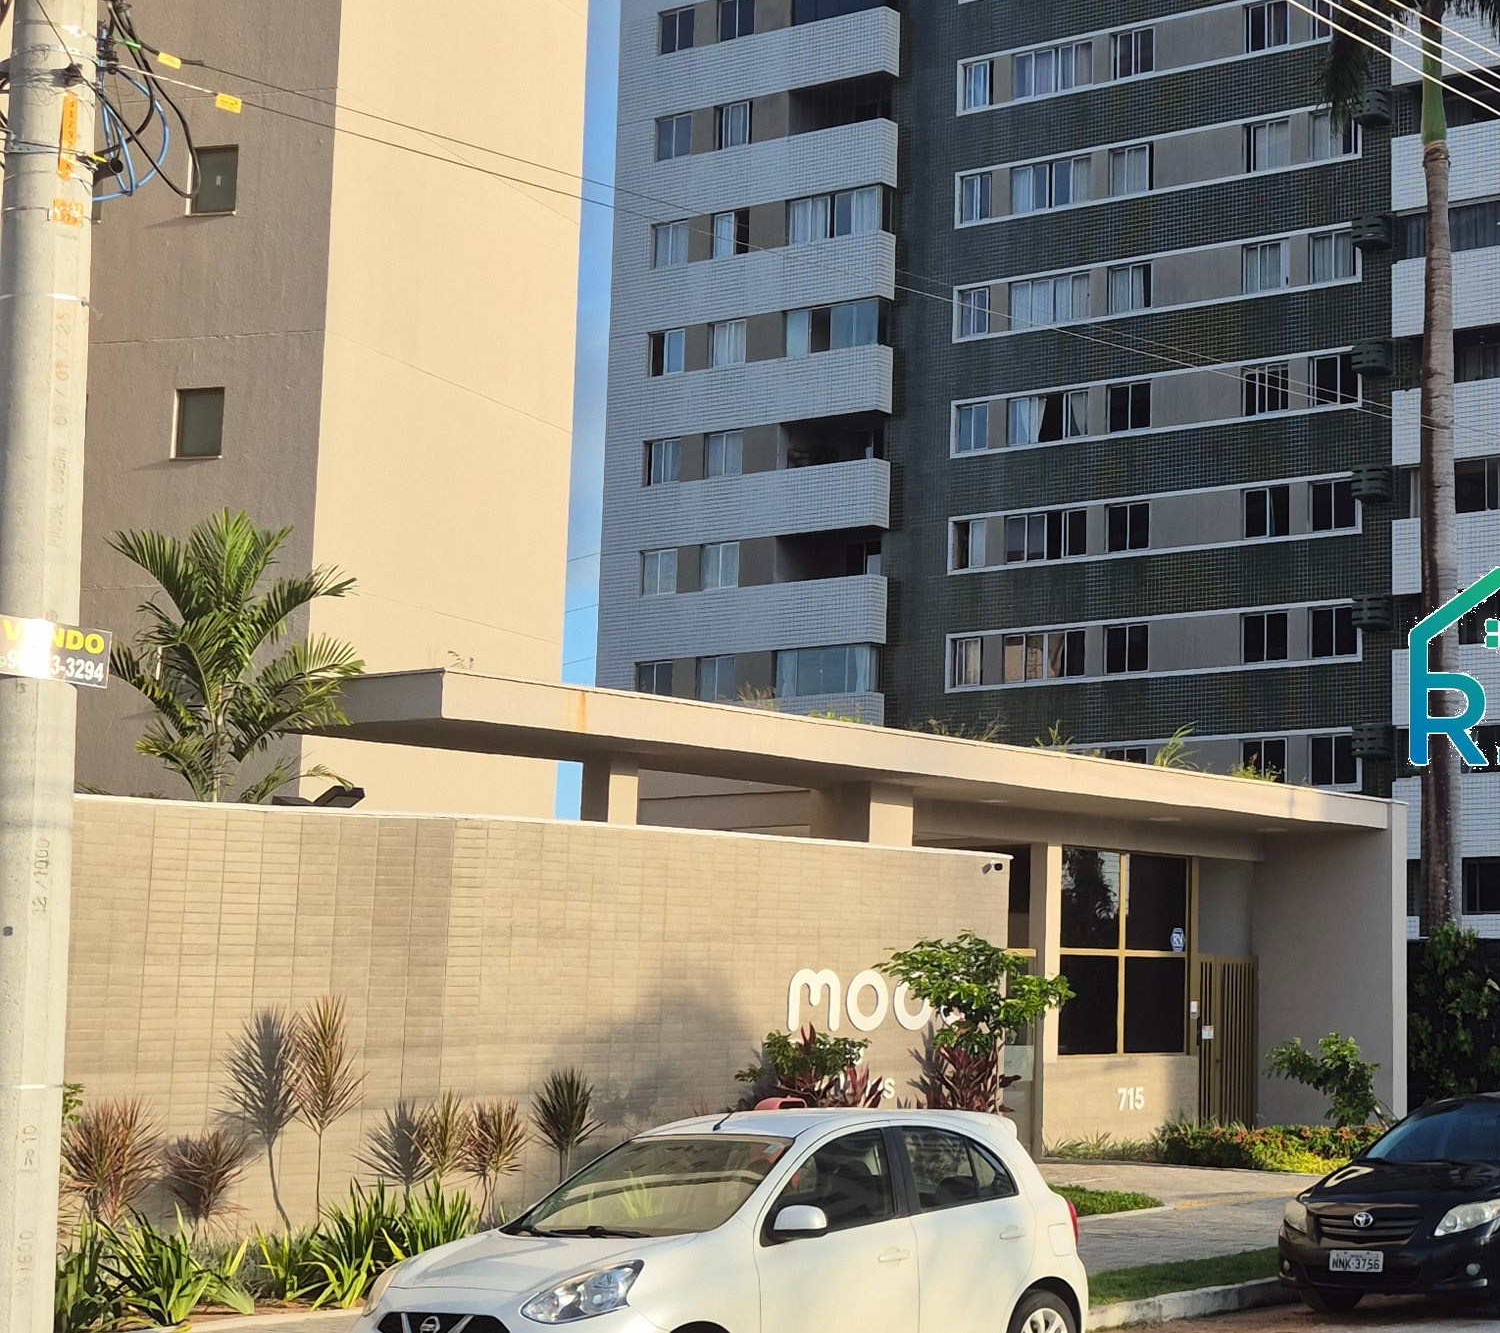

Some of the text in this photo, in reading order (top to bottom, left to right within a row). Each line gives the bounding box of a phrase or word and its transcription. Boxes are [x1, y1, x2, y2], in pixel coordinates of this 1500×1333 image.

[3, 619, 105, 655] VNDO
[7, 648, 105, 683] 93-3294
[1116, 1086, 1145, 1111] 715
